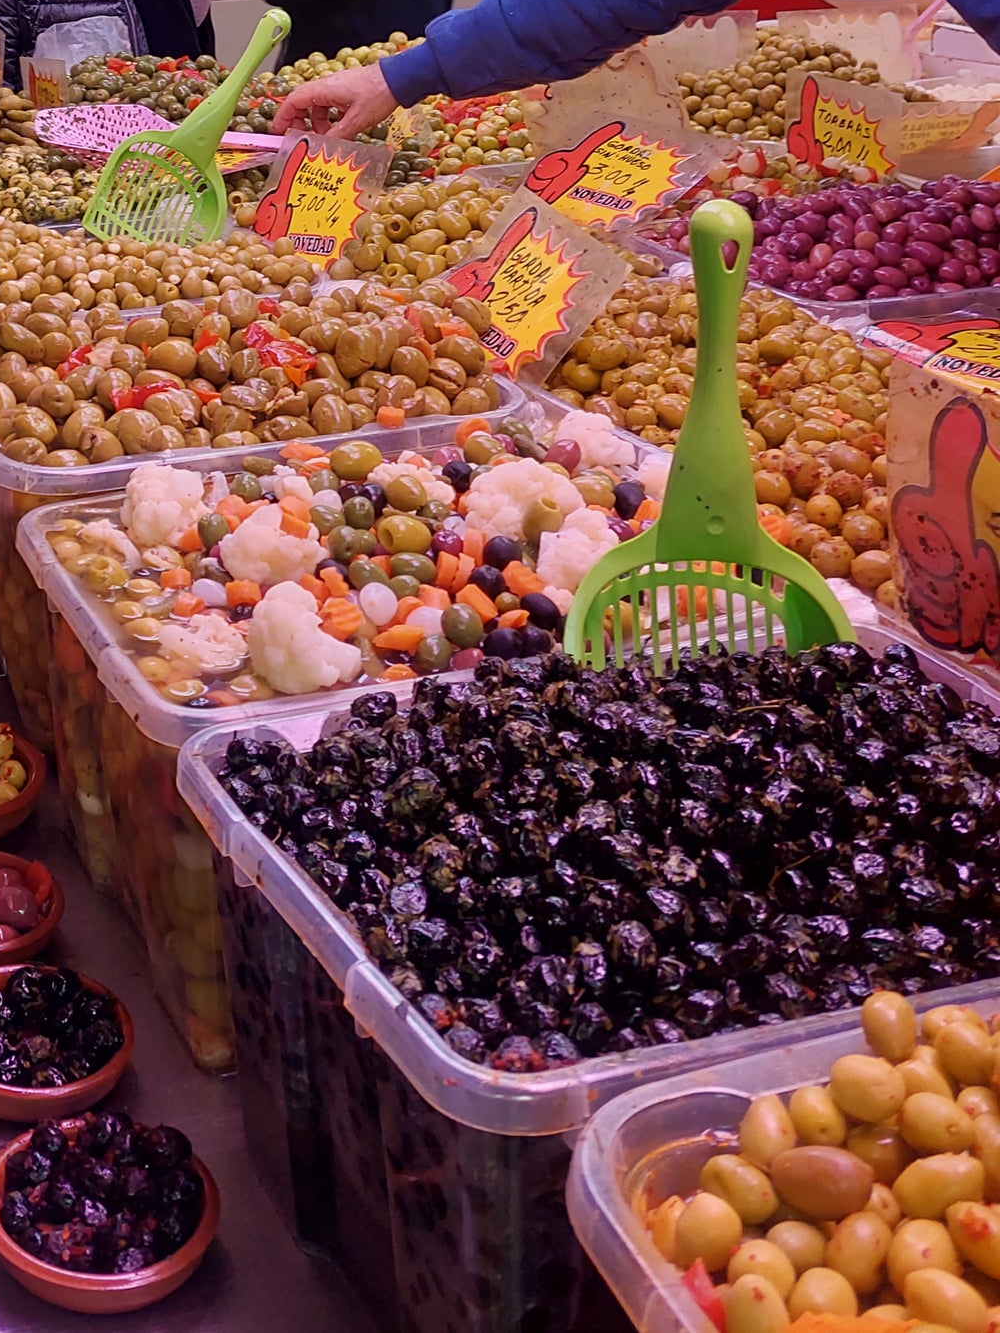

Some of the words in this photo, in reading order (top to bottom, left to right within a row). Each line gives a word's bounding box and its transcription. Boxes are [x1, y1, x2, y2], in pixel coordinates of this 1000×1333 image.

[569, 186, 634, 210] NOVEDAD
[510, 246, 554, 284] GORDAL
[480, 327, 515, 357] EDAD
